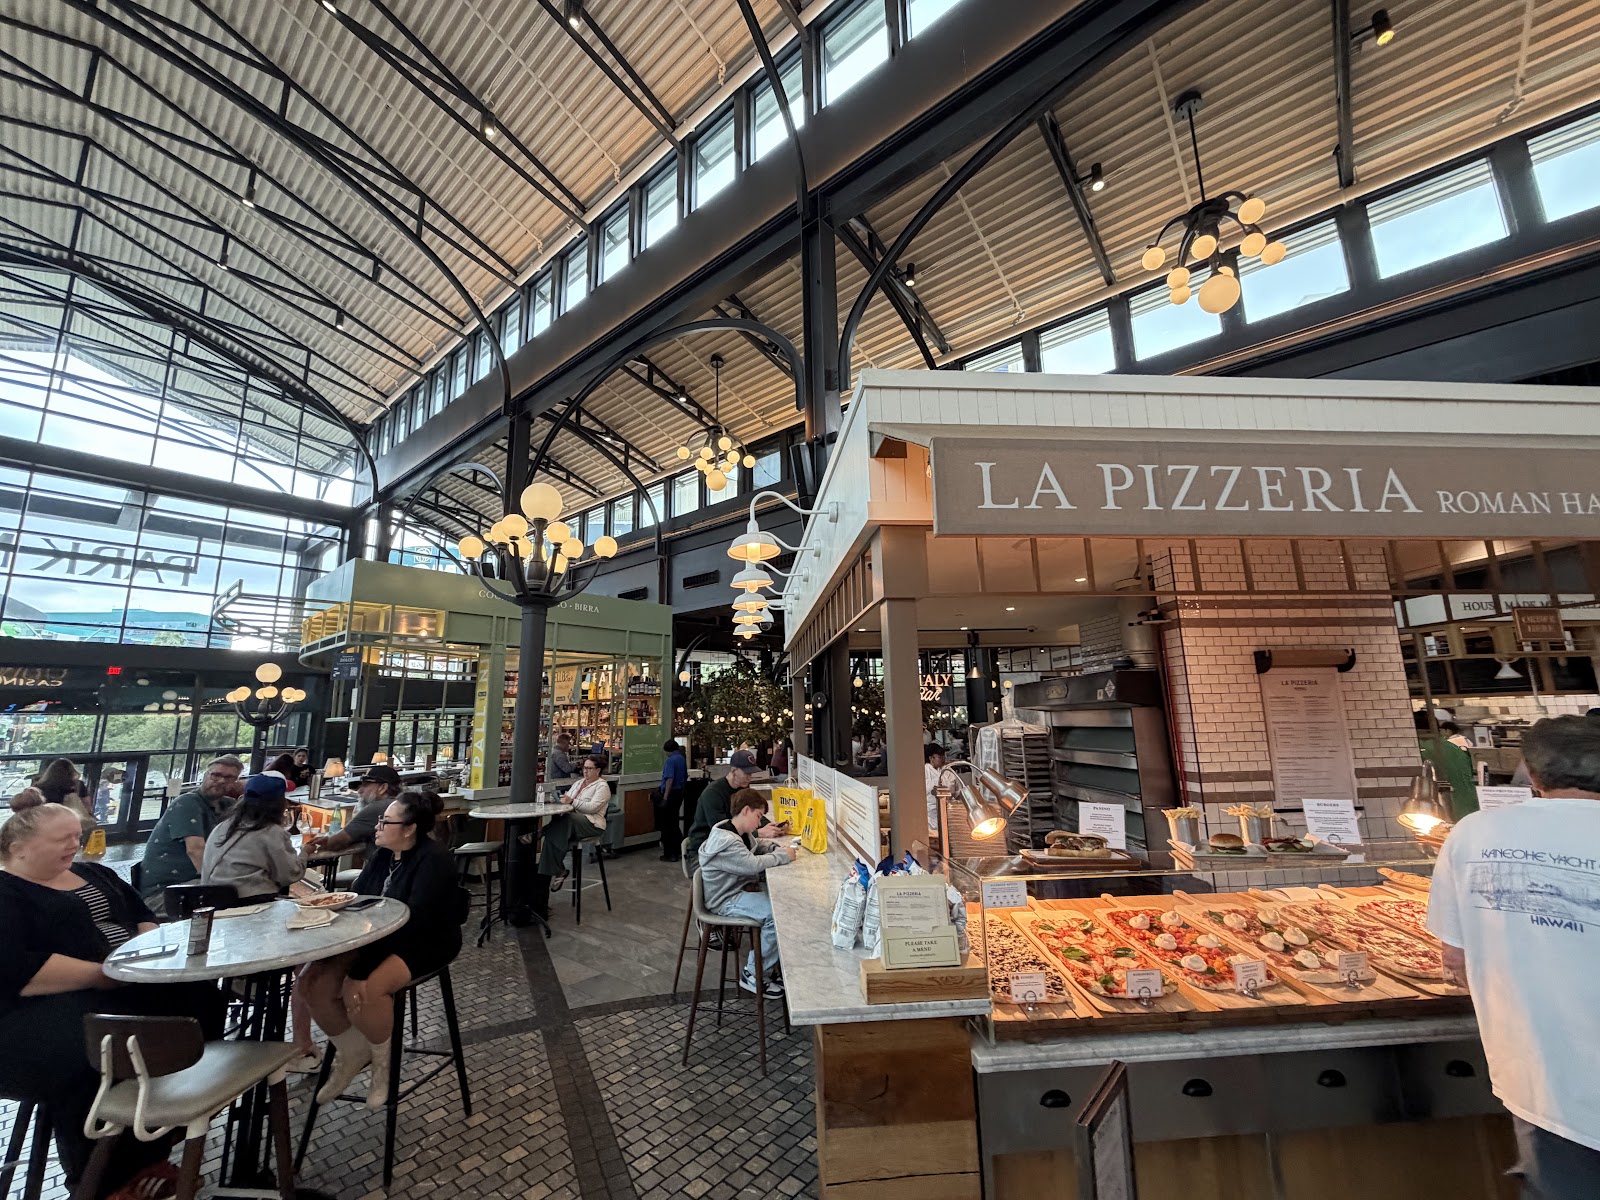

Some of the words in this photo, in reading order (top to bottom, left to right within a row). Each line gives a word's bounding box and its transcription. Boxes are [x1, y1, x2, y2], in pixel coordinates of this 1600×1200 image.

[974, 461, 1077, 510] LA
[1096, 463, 1424, 513] PIZZERIA
[1436, 490, 1552, 514] ROMAN
[574, 602, 600, 613] BIRRA
[1463, 601, 1496, 611] HOUS
[1481, 848, 1547, 863] KANEOHE
[1548, 853, 1597, 870] YACHT
[1530, 914, 1584, 934] HAWAII
